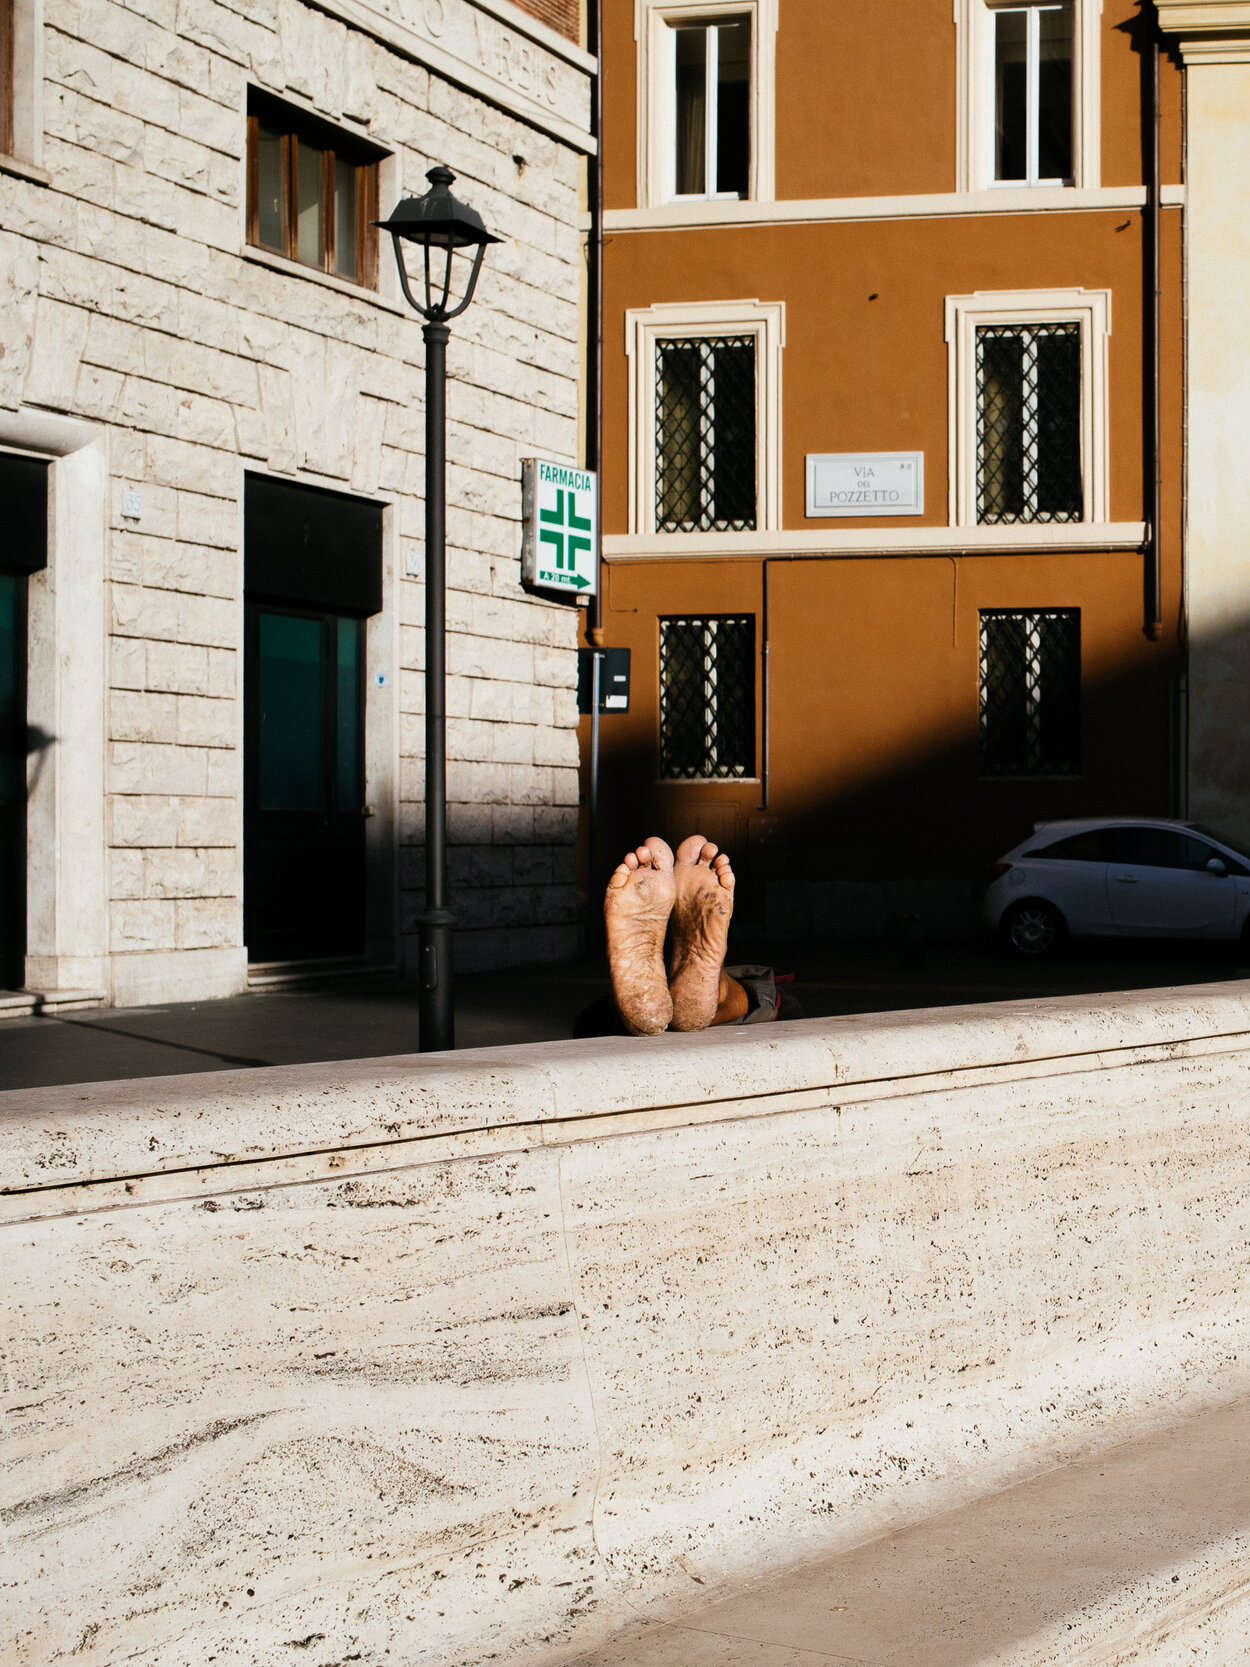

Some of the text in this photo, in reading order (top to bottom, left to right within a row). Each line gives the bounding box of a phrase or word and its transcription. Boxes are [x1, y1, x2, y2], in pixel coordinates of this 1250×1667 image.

[540, 463, 591, 492] FARMACIA
[853, 466, 876, 479] VIA
[829, 490, 900, 503] POZZETTO
[543, 571, 549, 580] A
